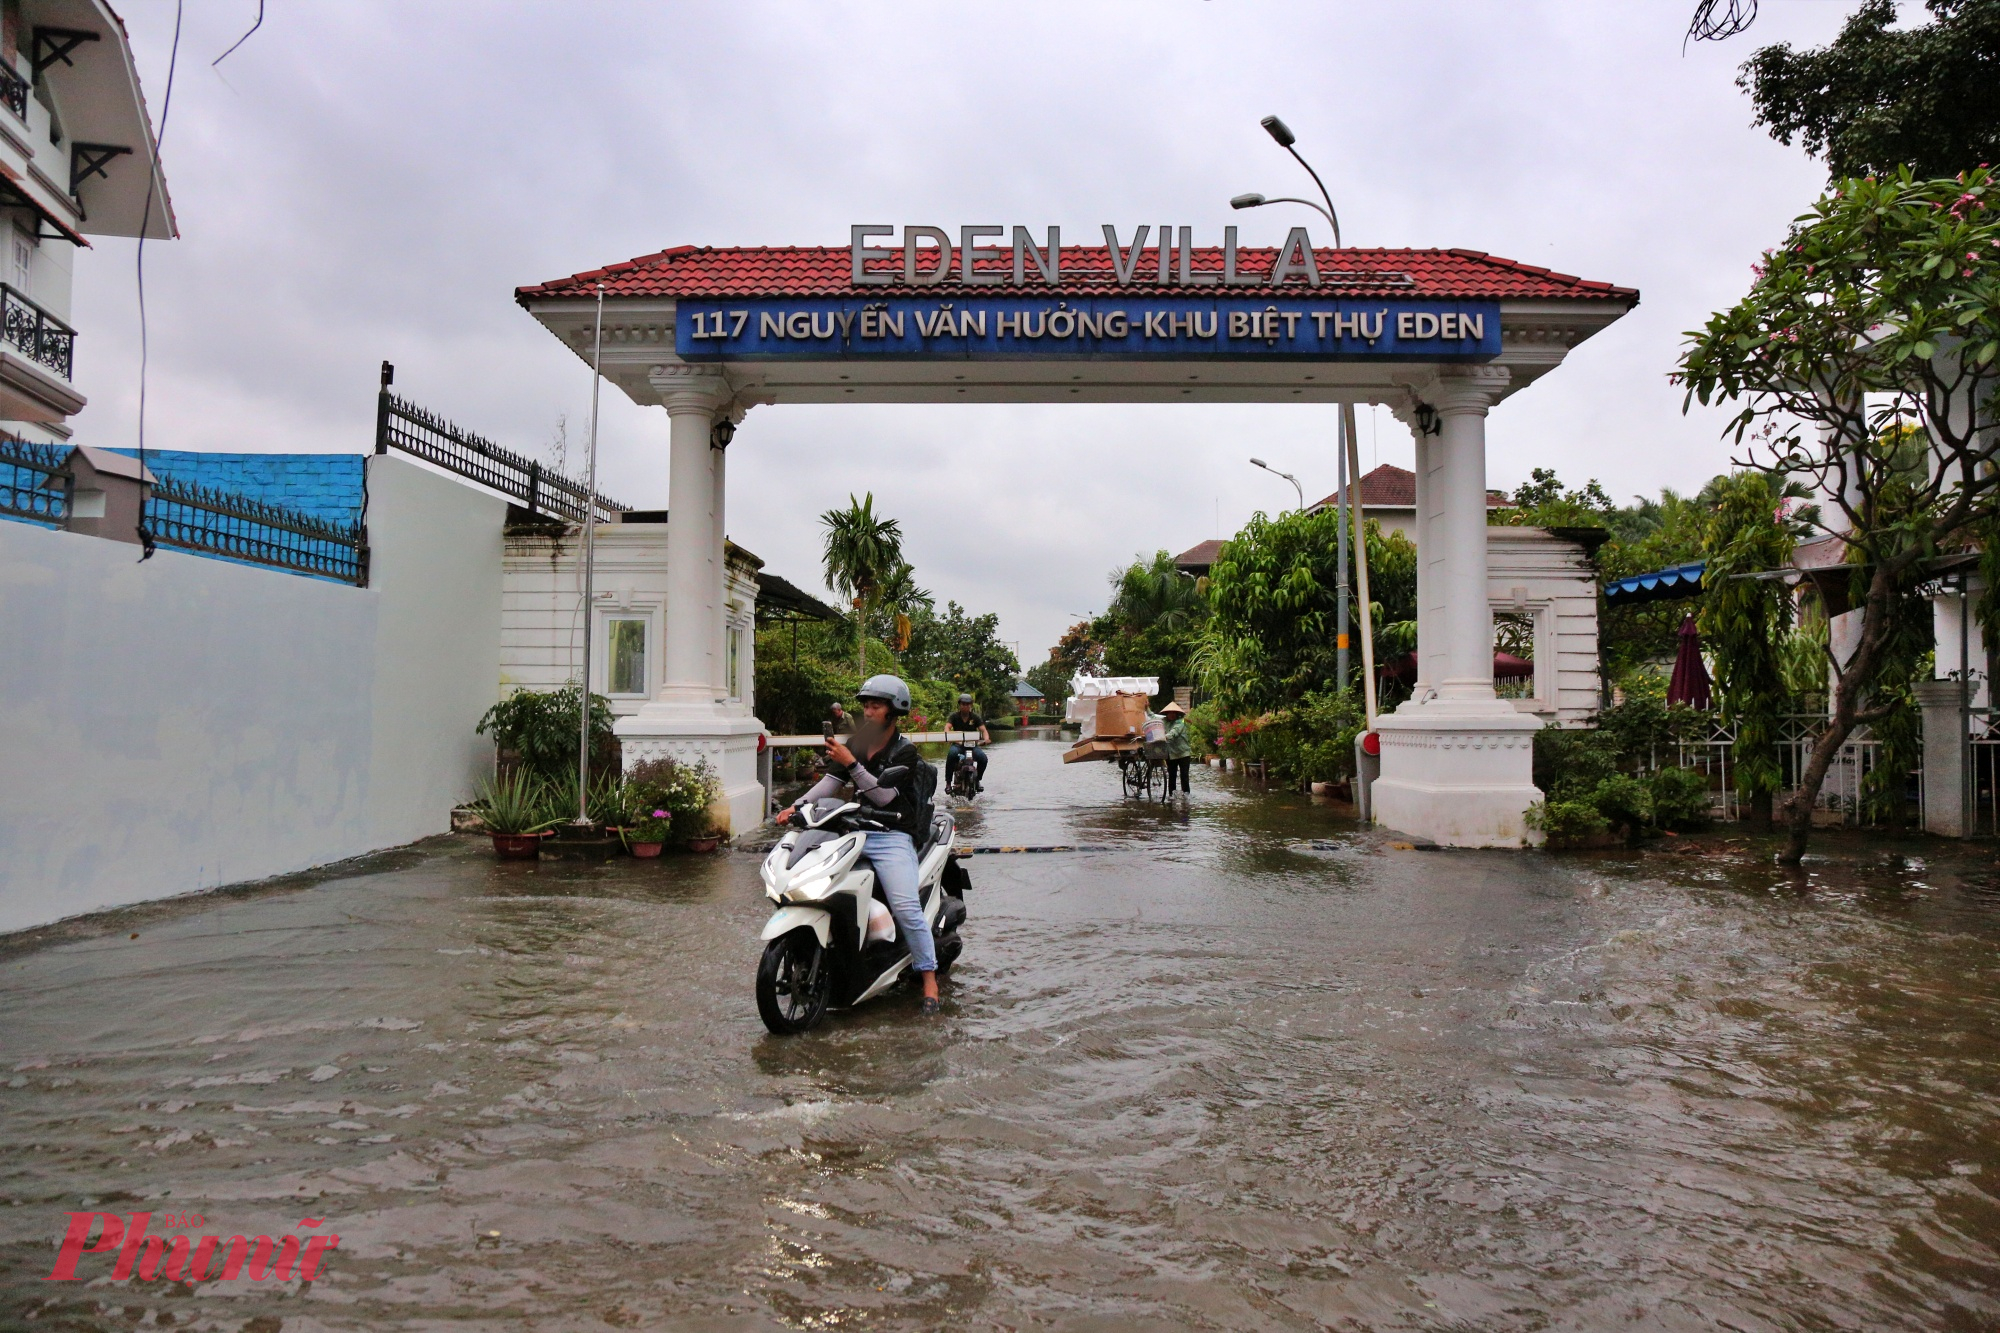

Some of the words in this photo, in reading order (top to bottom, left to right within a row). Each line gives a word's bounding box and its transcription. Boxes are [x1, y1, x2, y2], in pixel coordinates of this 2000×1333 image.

[850, 224, 1061, 286] EDEN
[1100, 223, 1322, 287] VILLA
[690, 310, 749, 339] 117
[759, 302, 905, 340] NGUYỄN
[914, 302, 987, 339] VĂN
[1227, 305, 1303, 347] BIỆT
[1310, 307, 1389, 347] THỰ
[1396, 311, 1485, 340] EDEN
